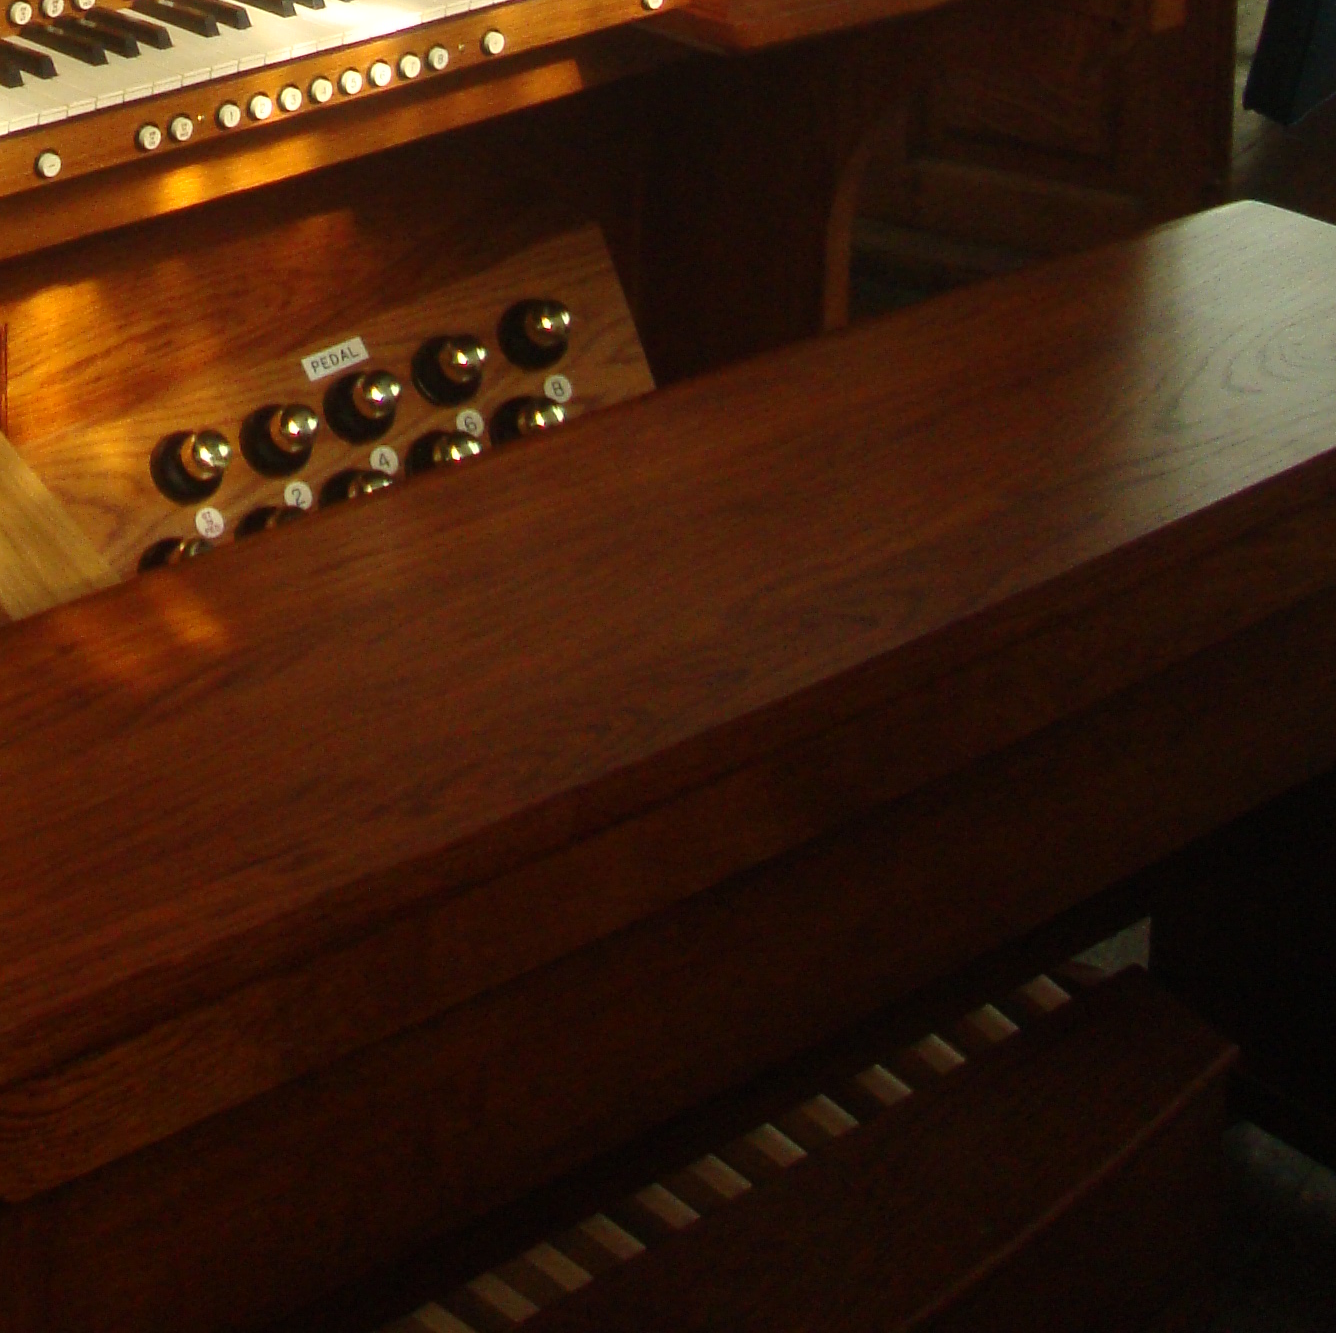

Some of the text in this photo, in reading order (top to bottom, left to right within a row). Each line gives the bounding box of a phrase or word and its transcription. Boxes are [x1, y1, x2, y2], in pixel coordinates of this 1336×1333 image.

[311, 346, 360, 374] PEDAL
[552, 381, 565, 397] 8
[464, 416, 478, 433] 6
[379, 452, 390, 467] 4
[291, 487, 306, 507] 2
